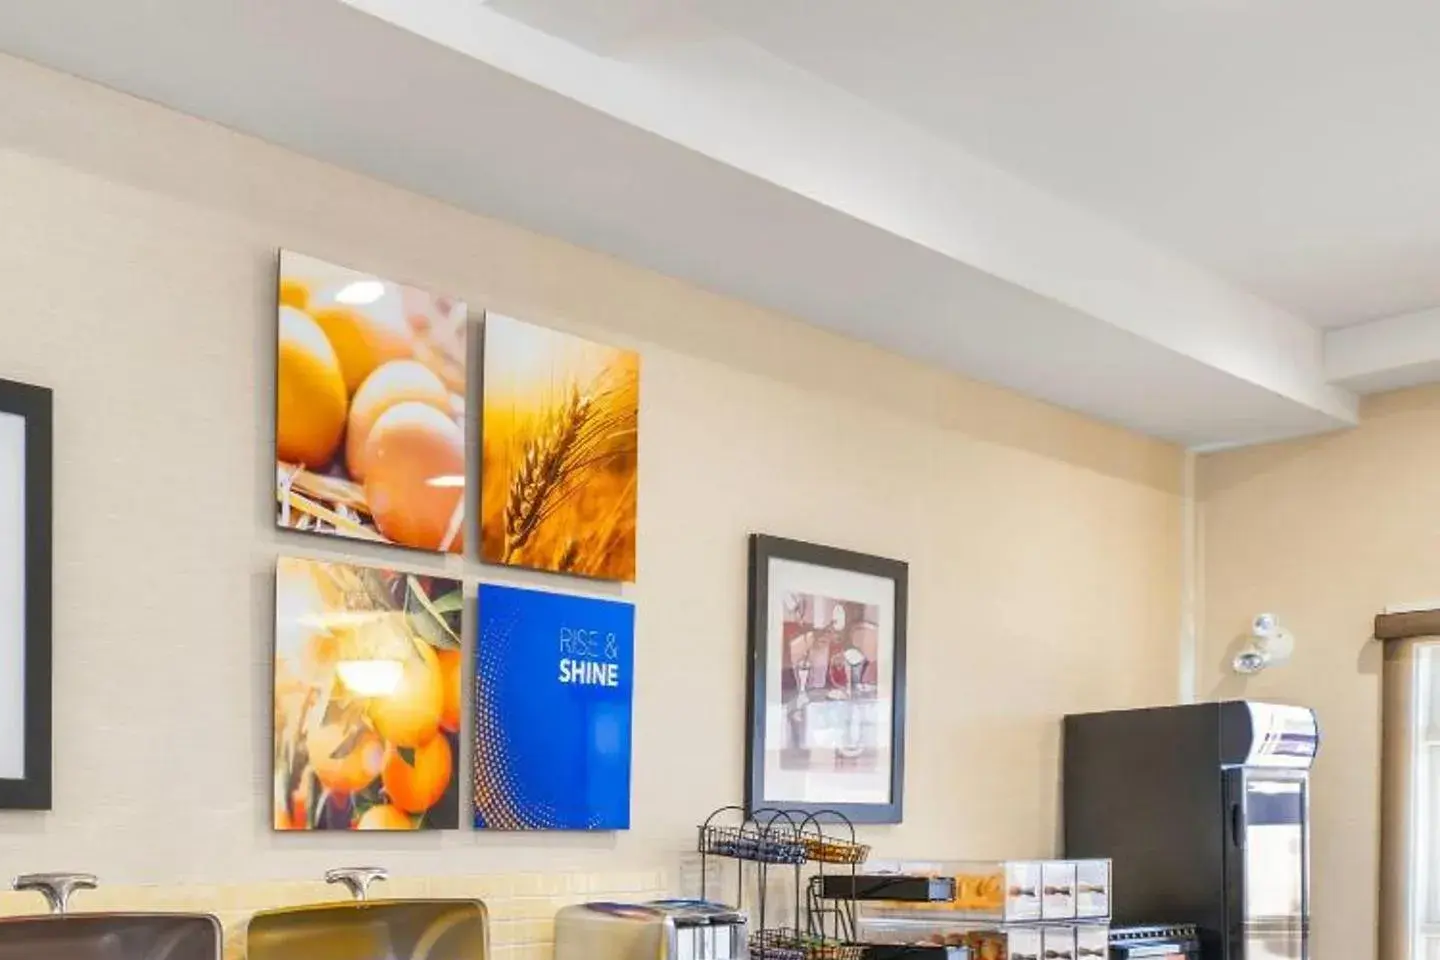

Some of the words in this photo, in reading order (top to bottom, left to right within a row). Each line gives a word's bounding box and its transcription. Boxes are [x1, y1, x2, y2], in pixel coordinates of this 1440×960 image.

[560, 627, 598, 657] RISE
[605, 632, 618, 660] &
[558, 658, 619, 687] SHINE
